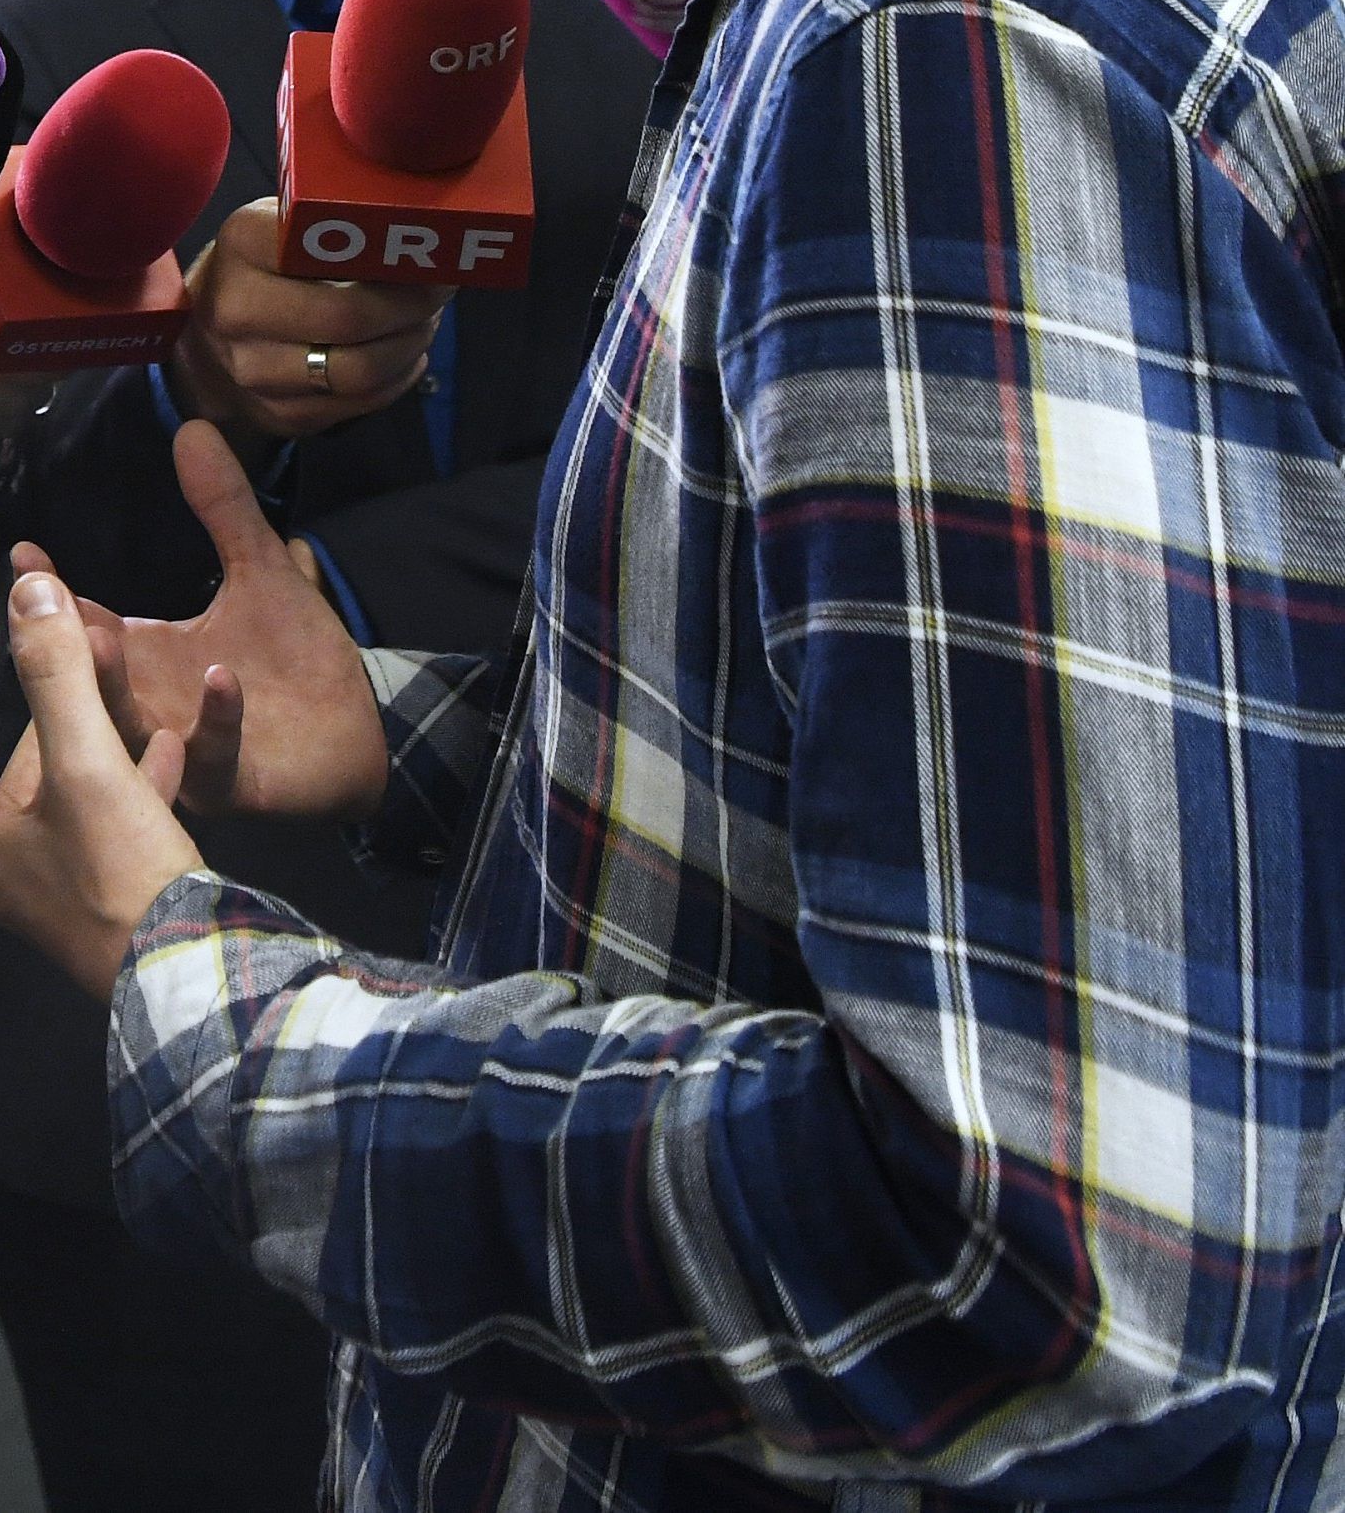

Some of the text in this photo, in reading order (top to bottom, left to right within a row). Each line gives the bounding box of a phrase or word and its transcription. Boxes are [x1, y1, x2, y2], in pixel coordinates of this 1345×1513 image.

[429, 26, 518, 74] ORF
[302, 219, 514, 271] ORF
[6, 336, 148, 355] ÖSTERREICH
